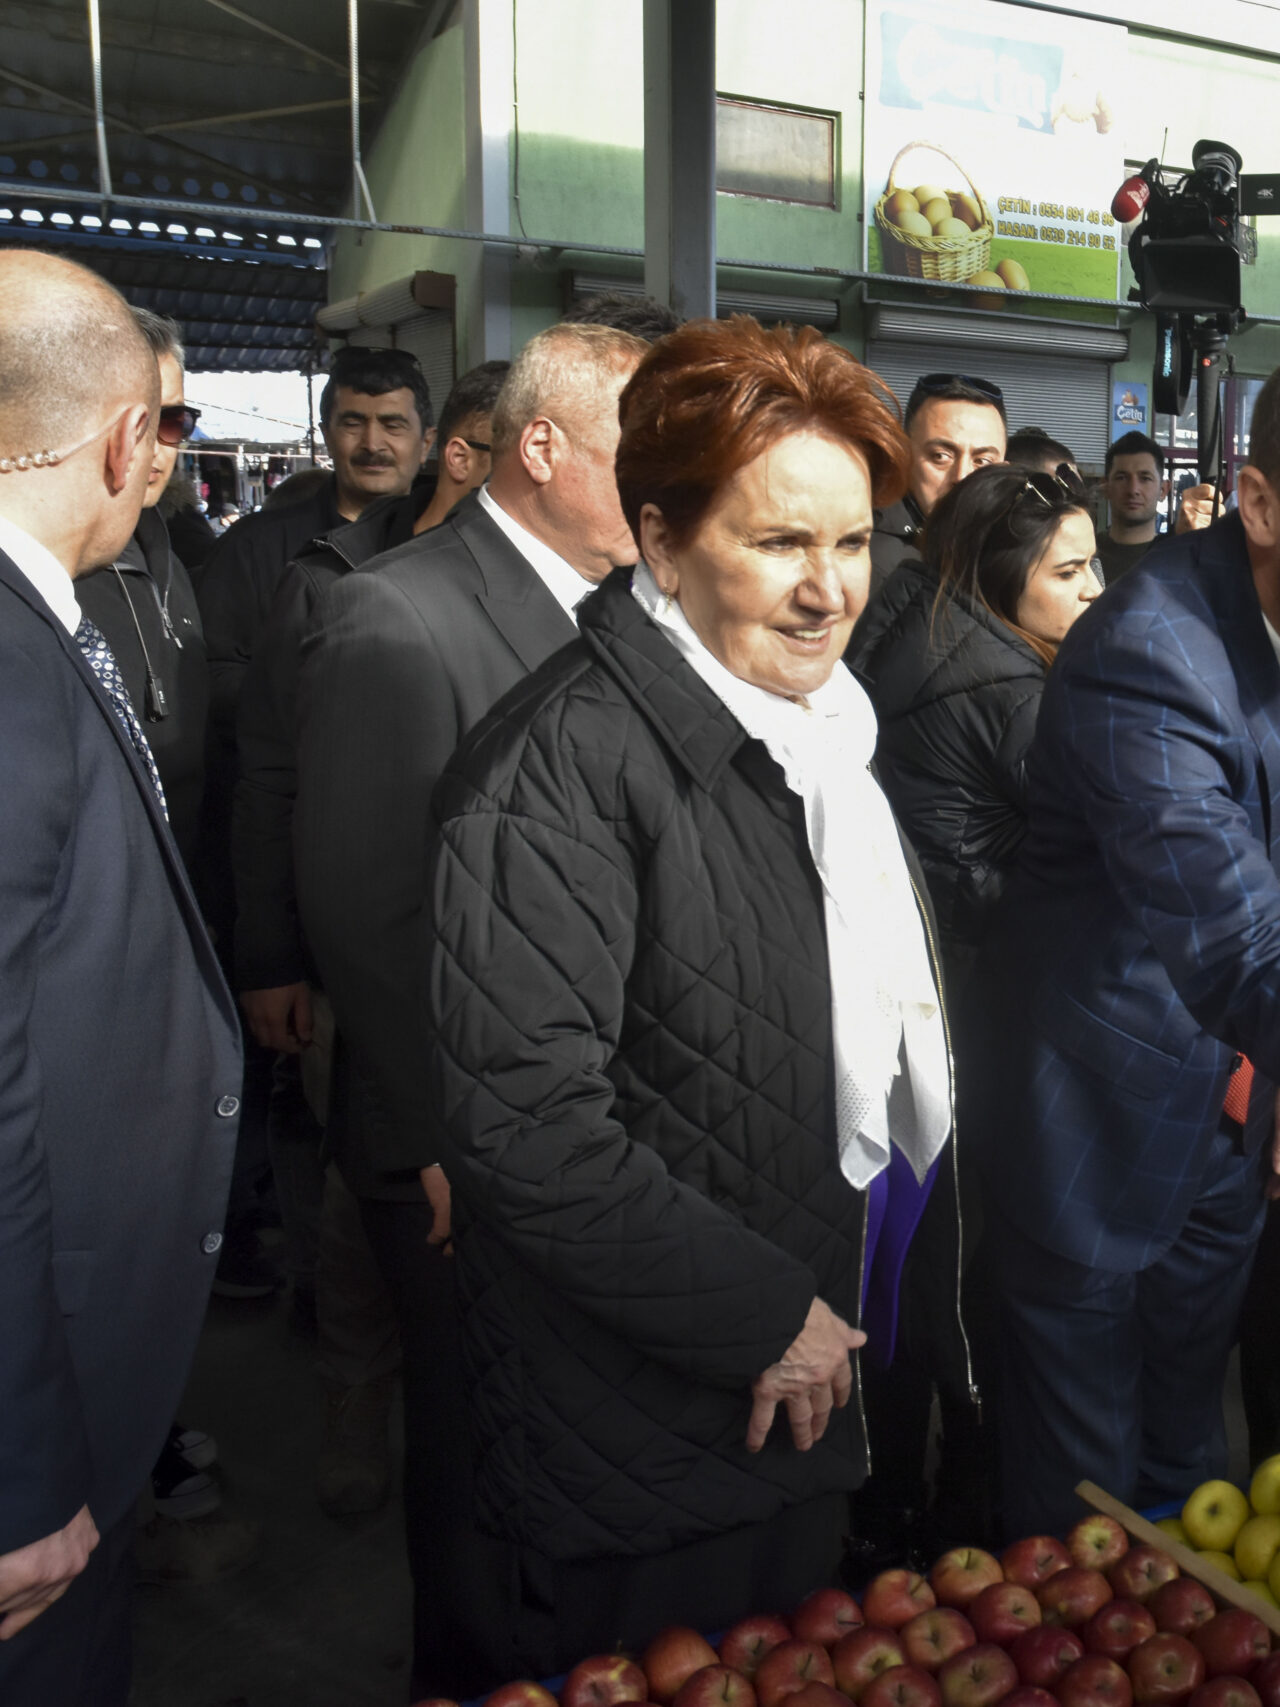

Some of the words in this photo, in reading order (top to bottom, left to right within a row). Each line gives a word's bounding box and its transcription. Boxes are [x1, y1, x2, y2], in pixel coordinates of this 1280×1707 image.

[998, 196, 1031, 214] ÇETİN
[1040, 202, 1064, 219] 0554
[1067, 206, 1084, 222] 891
[1087, 210, 1099, 224] 46
[997, 220, 1038, 239] HASAN:
[1040, 226, 1065, 243] 0539
[1067, 229, 1086, 246] 214
[1088, 233, 1100, 248] 90
[1103, 235, 1115, 250] 52
[1163, 327, 1172, 377] Panasonic
